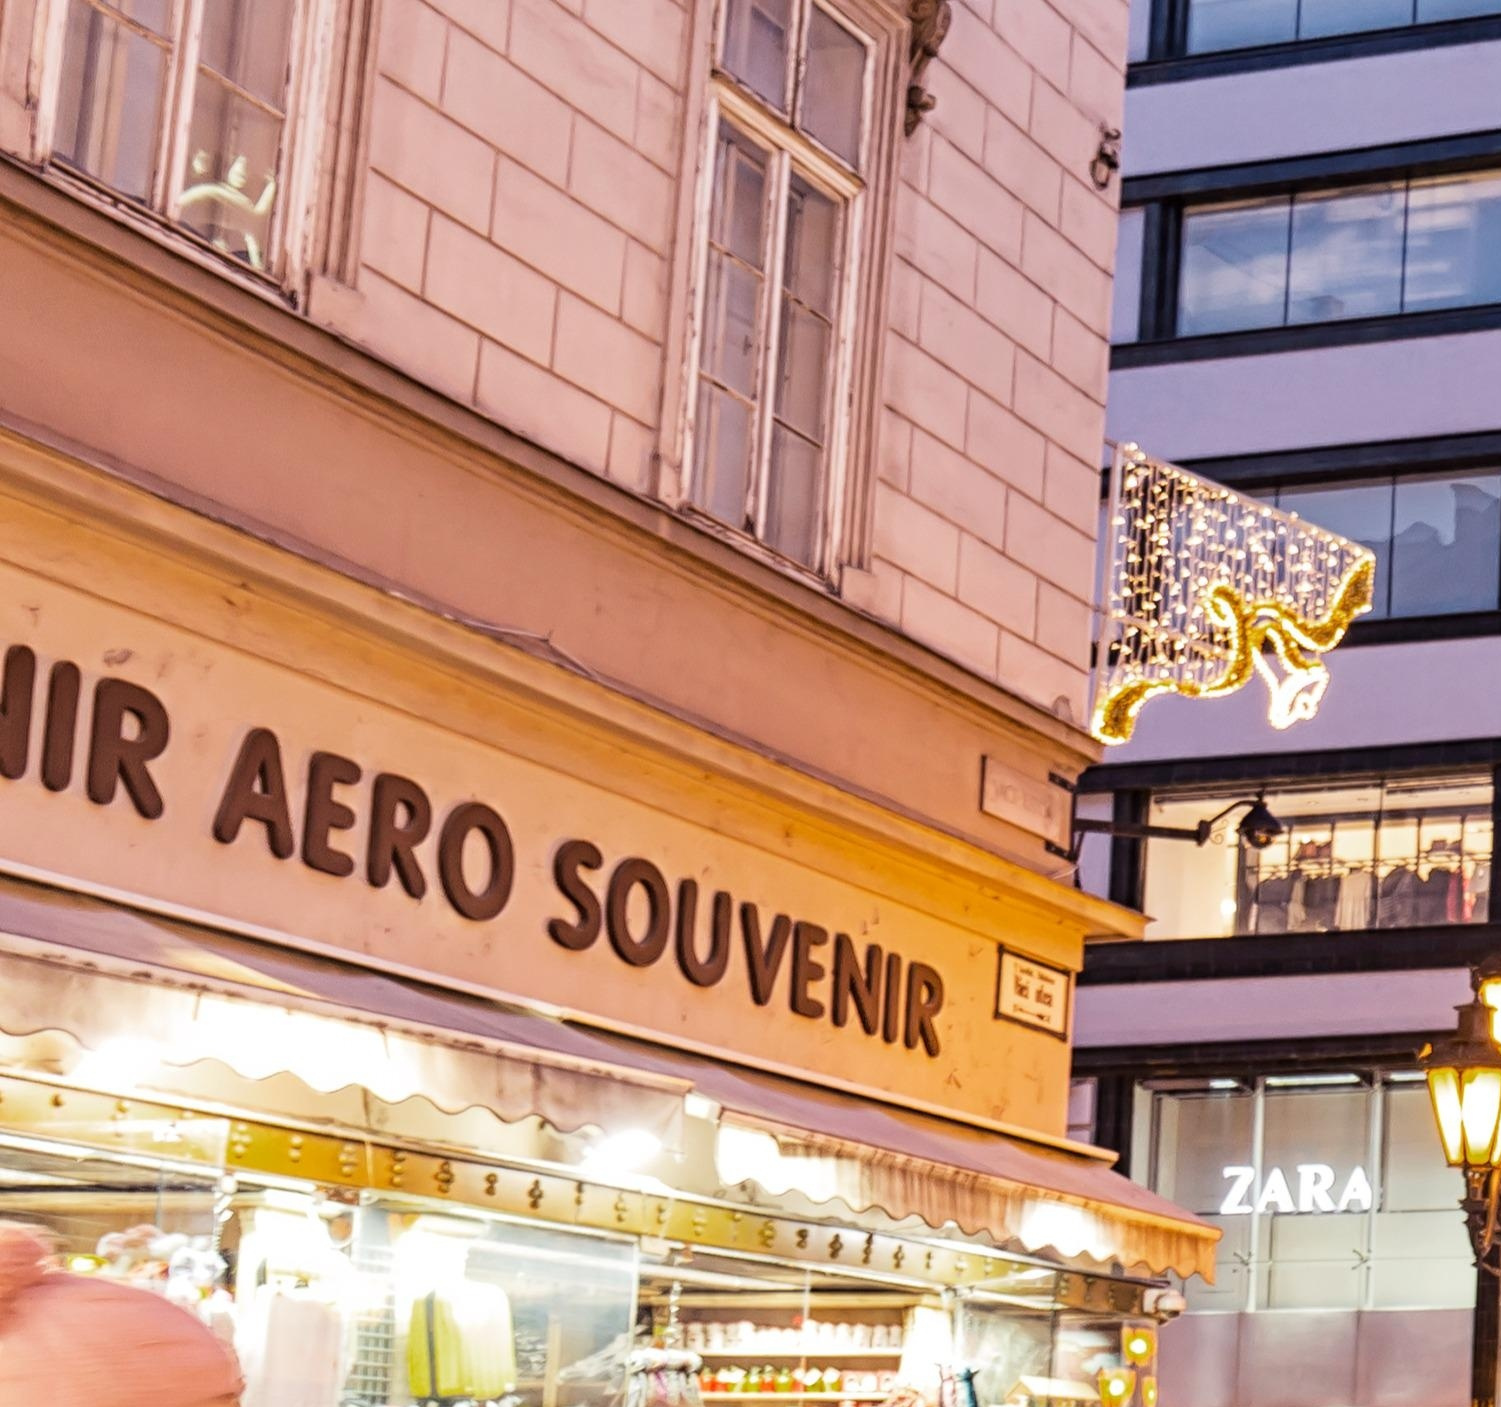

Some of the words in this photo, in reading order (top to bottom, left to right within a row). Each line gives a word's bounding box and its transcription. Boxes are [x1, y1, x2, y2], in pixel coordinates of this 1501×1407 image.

[212, 726, 515, 923] AERO
[547, 839, 947, 1059] SOUVENIR
[1219, 1163, 1373, 1215] ZARA
